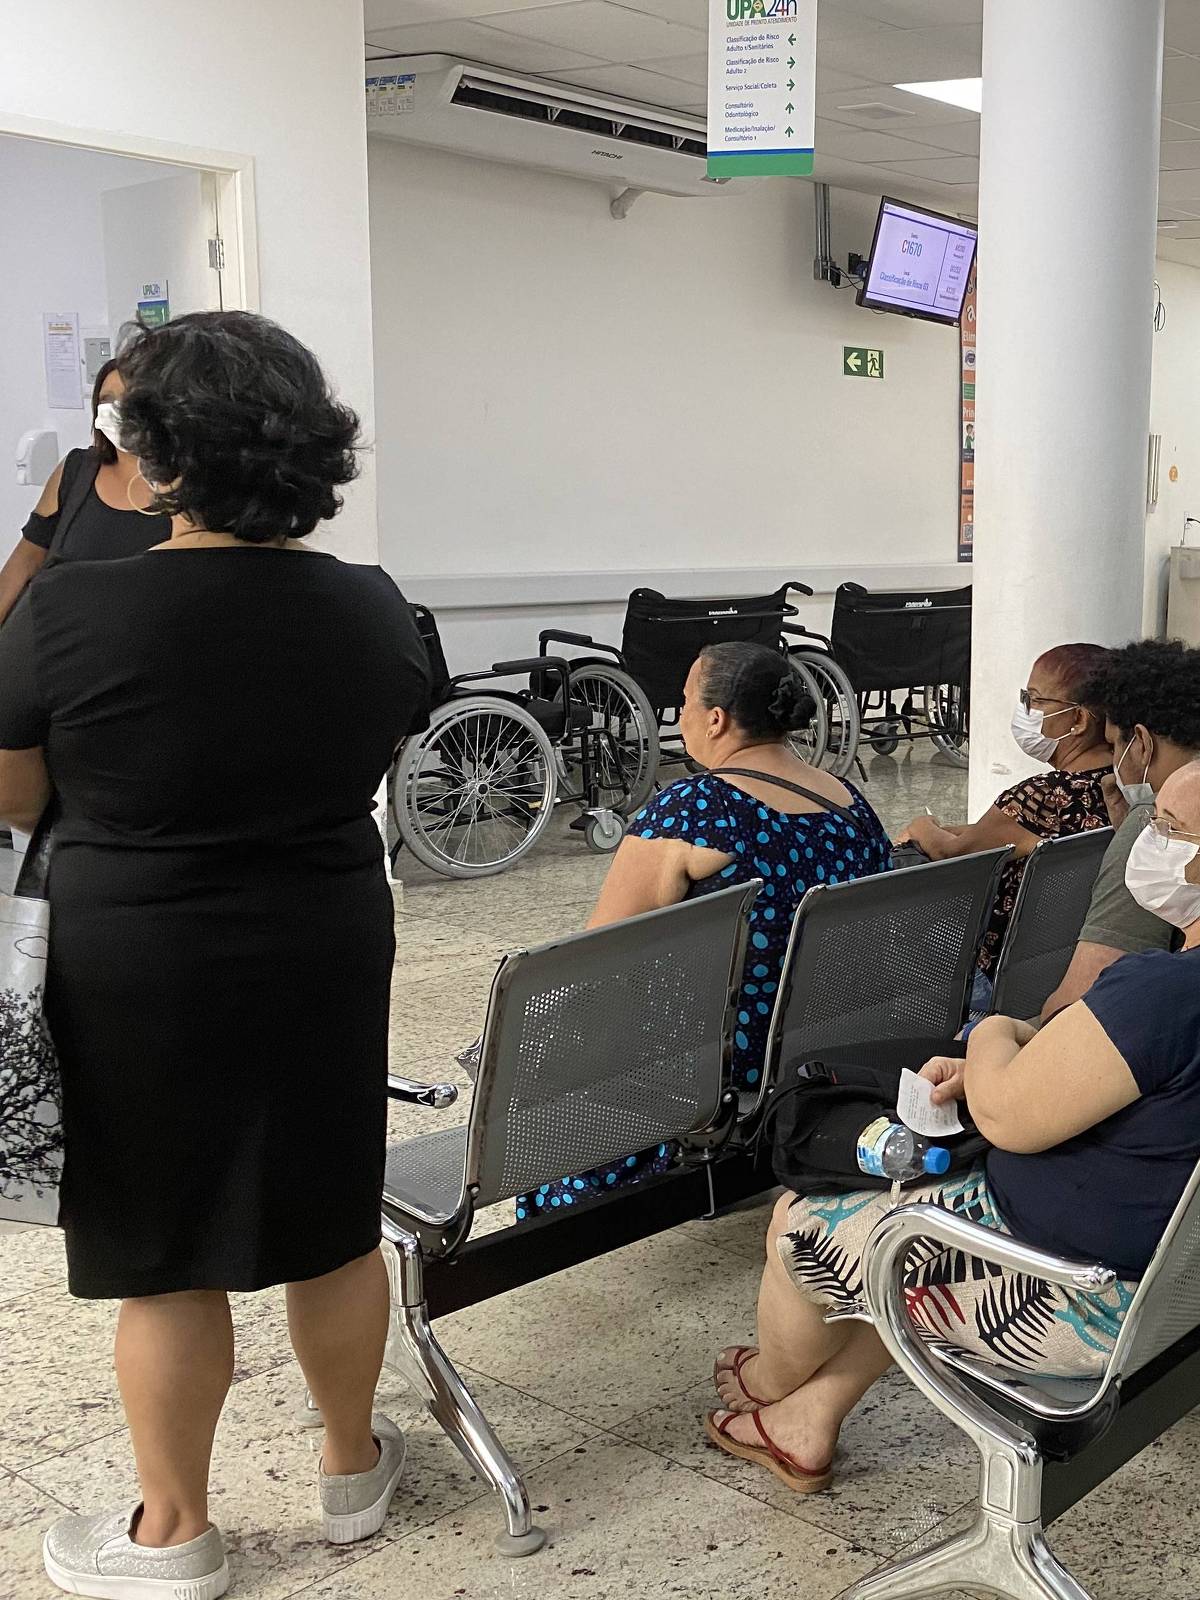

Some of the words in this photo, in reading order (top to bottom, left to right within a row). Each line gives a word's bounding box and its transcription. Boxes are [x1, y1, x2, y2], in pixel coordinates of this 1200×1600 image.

[726, 35, 757, 43] Classificação
[726, 57, 757, 66] Classificação
[725, 111, 759, 119] Odontológico
[591, 150, 623, 159] HITACHI
